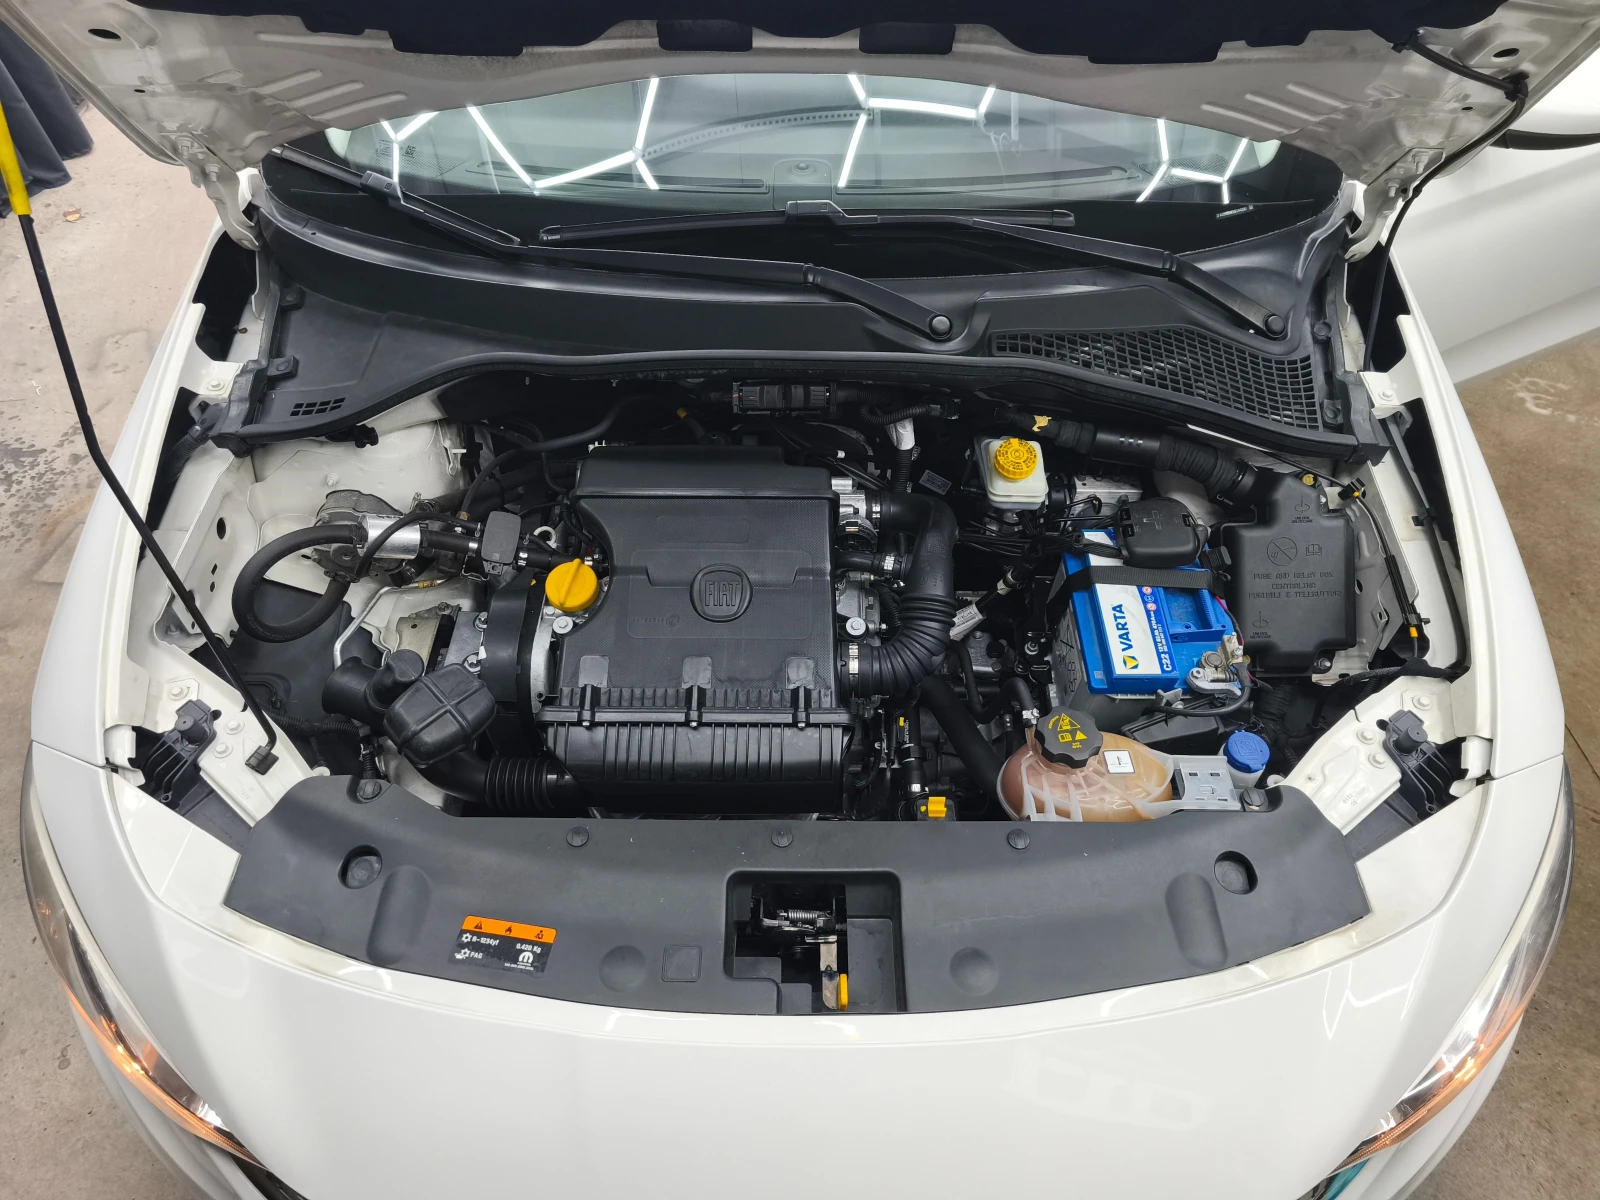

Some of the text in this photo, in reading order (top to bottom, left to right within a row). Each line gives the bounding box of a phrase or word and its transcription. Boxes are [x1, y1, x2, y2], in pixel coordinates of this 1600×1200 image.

[1253, 572, 1272, 580] FUSE
[1275, 572, 1290, 580] AND
[1293, 571, 1317, 579] RELAY
[1271, 582, 1316, 590] CENTRALINA
[704, 580, 740, 607] FIAT
[1111, 603, 1133, 653] VARTA
[1160, 653, 1173, 671] C22
[516, 943, 542, 954] 0.420 Kg
[470, 951, 483, 959] PAG
